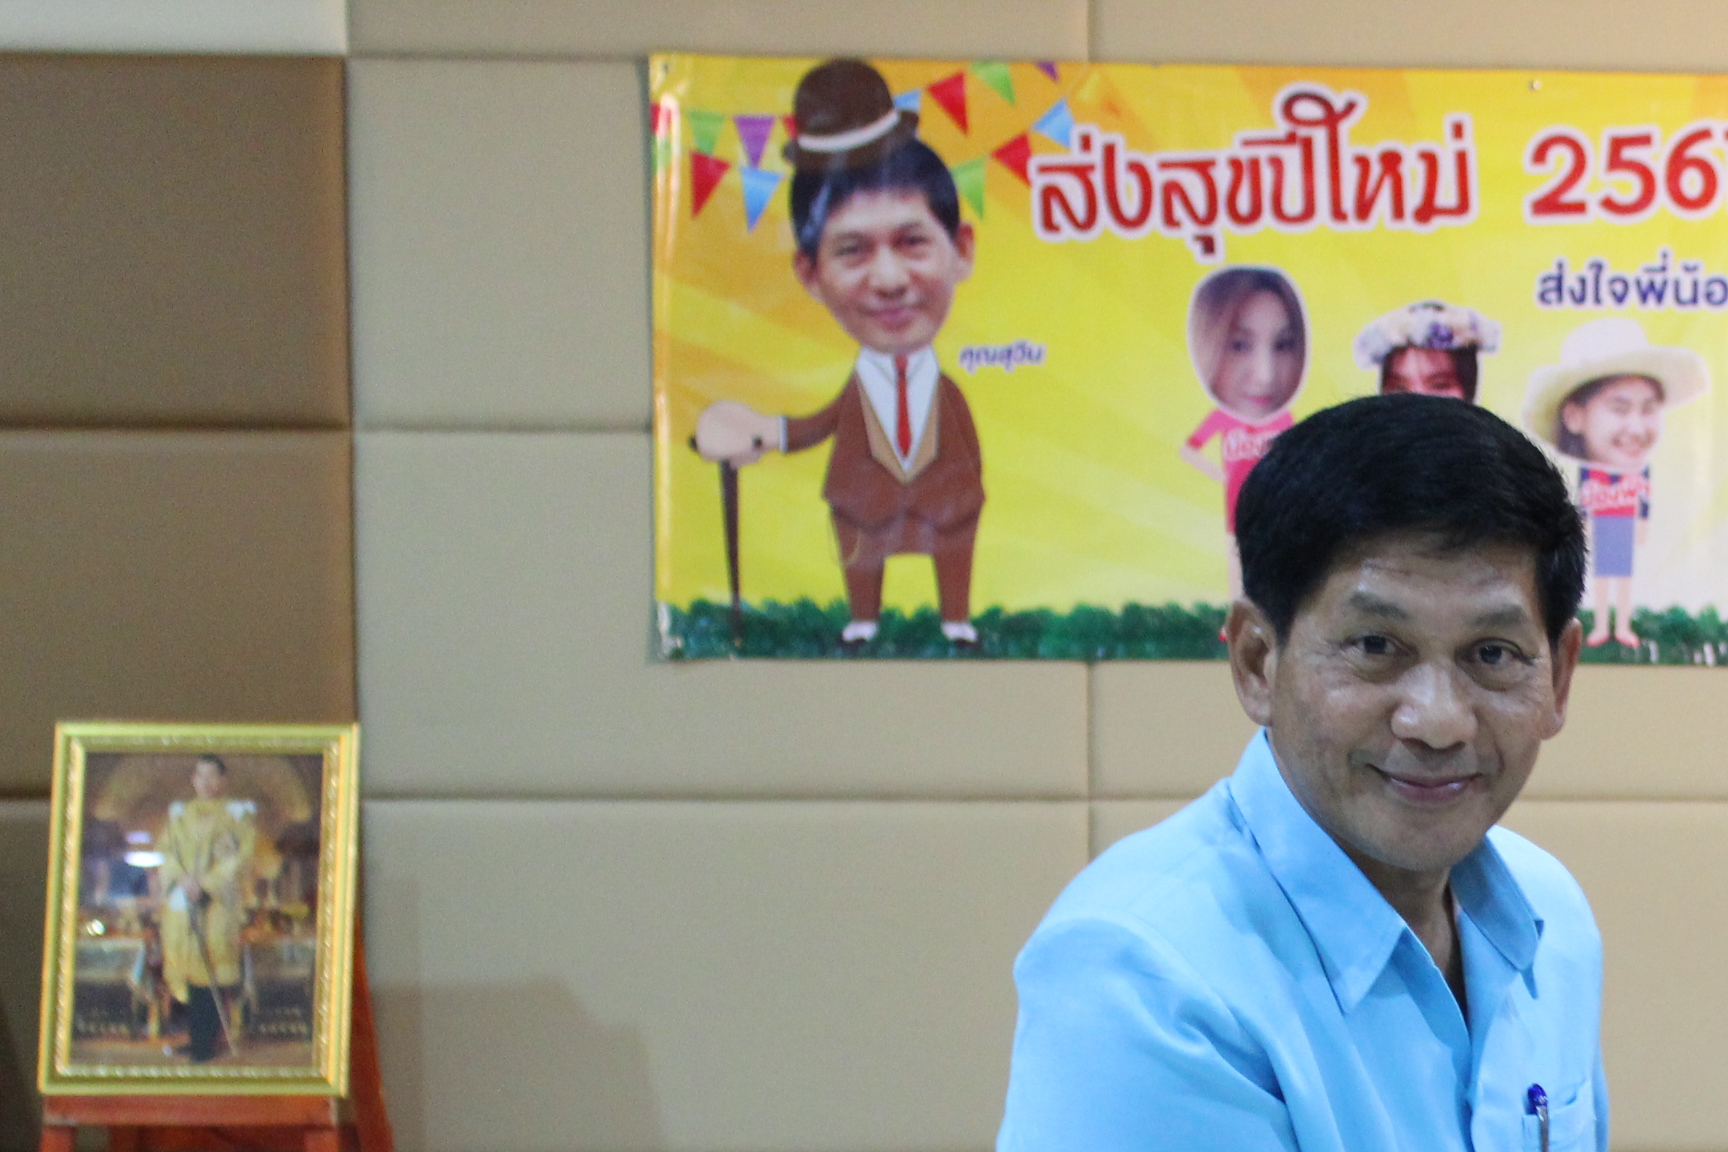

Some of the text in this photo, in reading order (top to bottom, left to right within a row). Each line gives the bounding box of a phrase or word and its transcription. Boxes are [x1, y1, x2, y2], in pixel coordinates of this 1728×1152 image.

[1035, 90, 1471, 256] ส่งสุขปีใหม่
